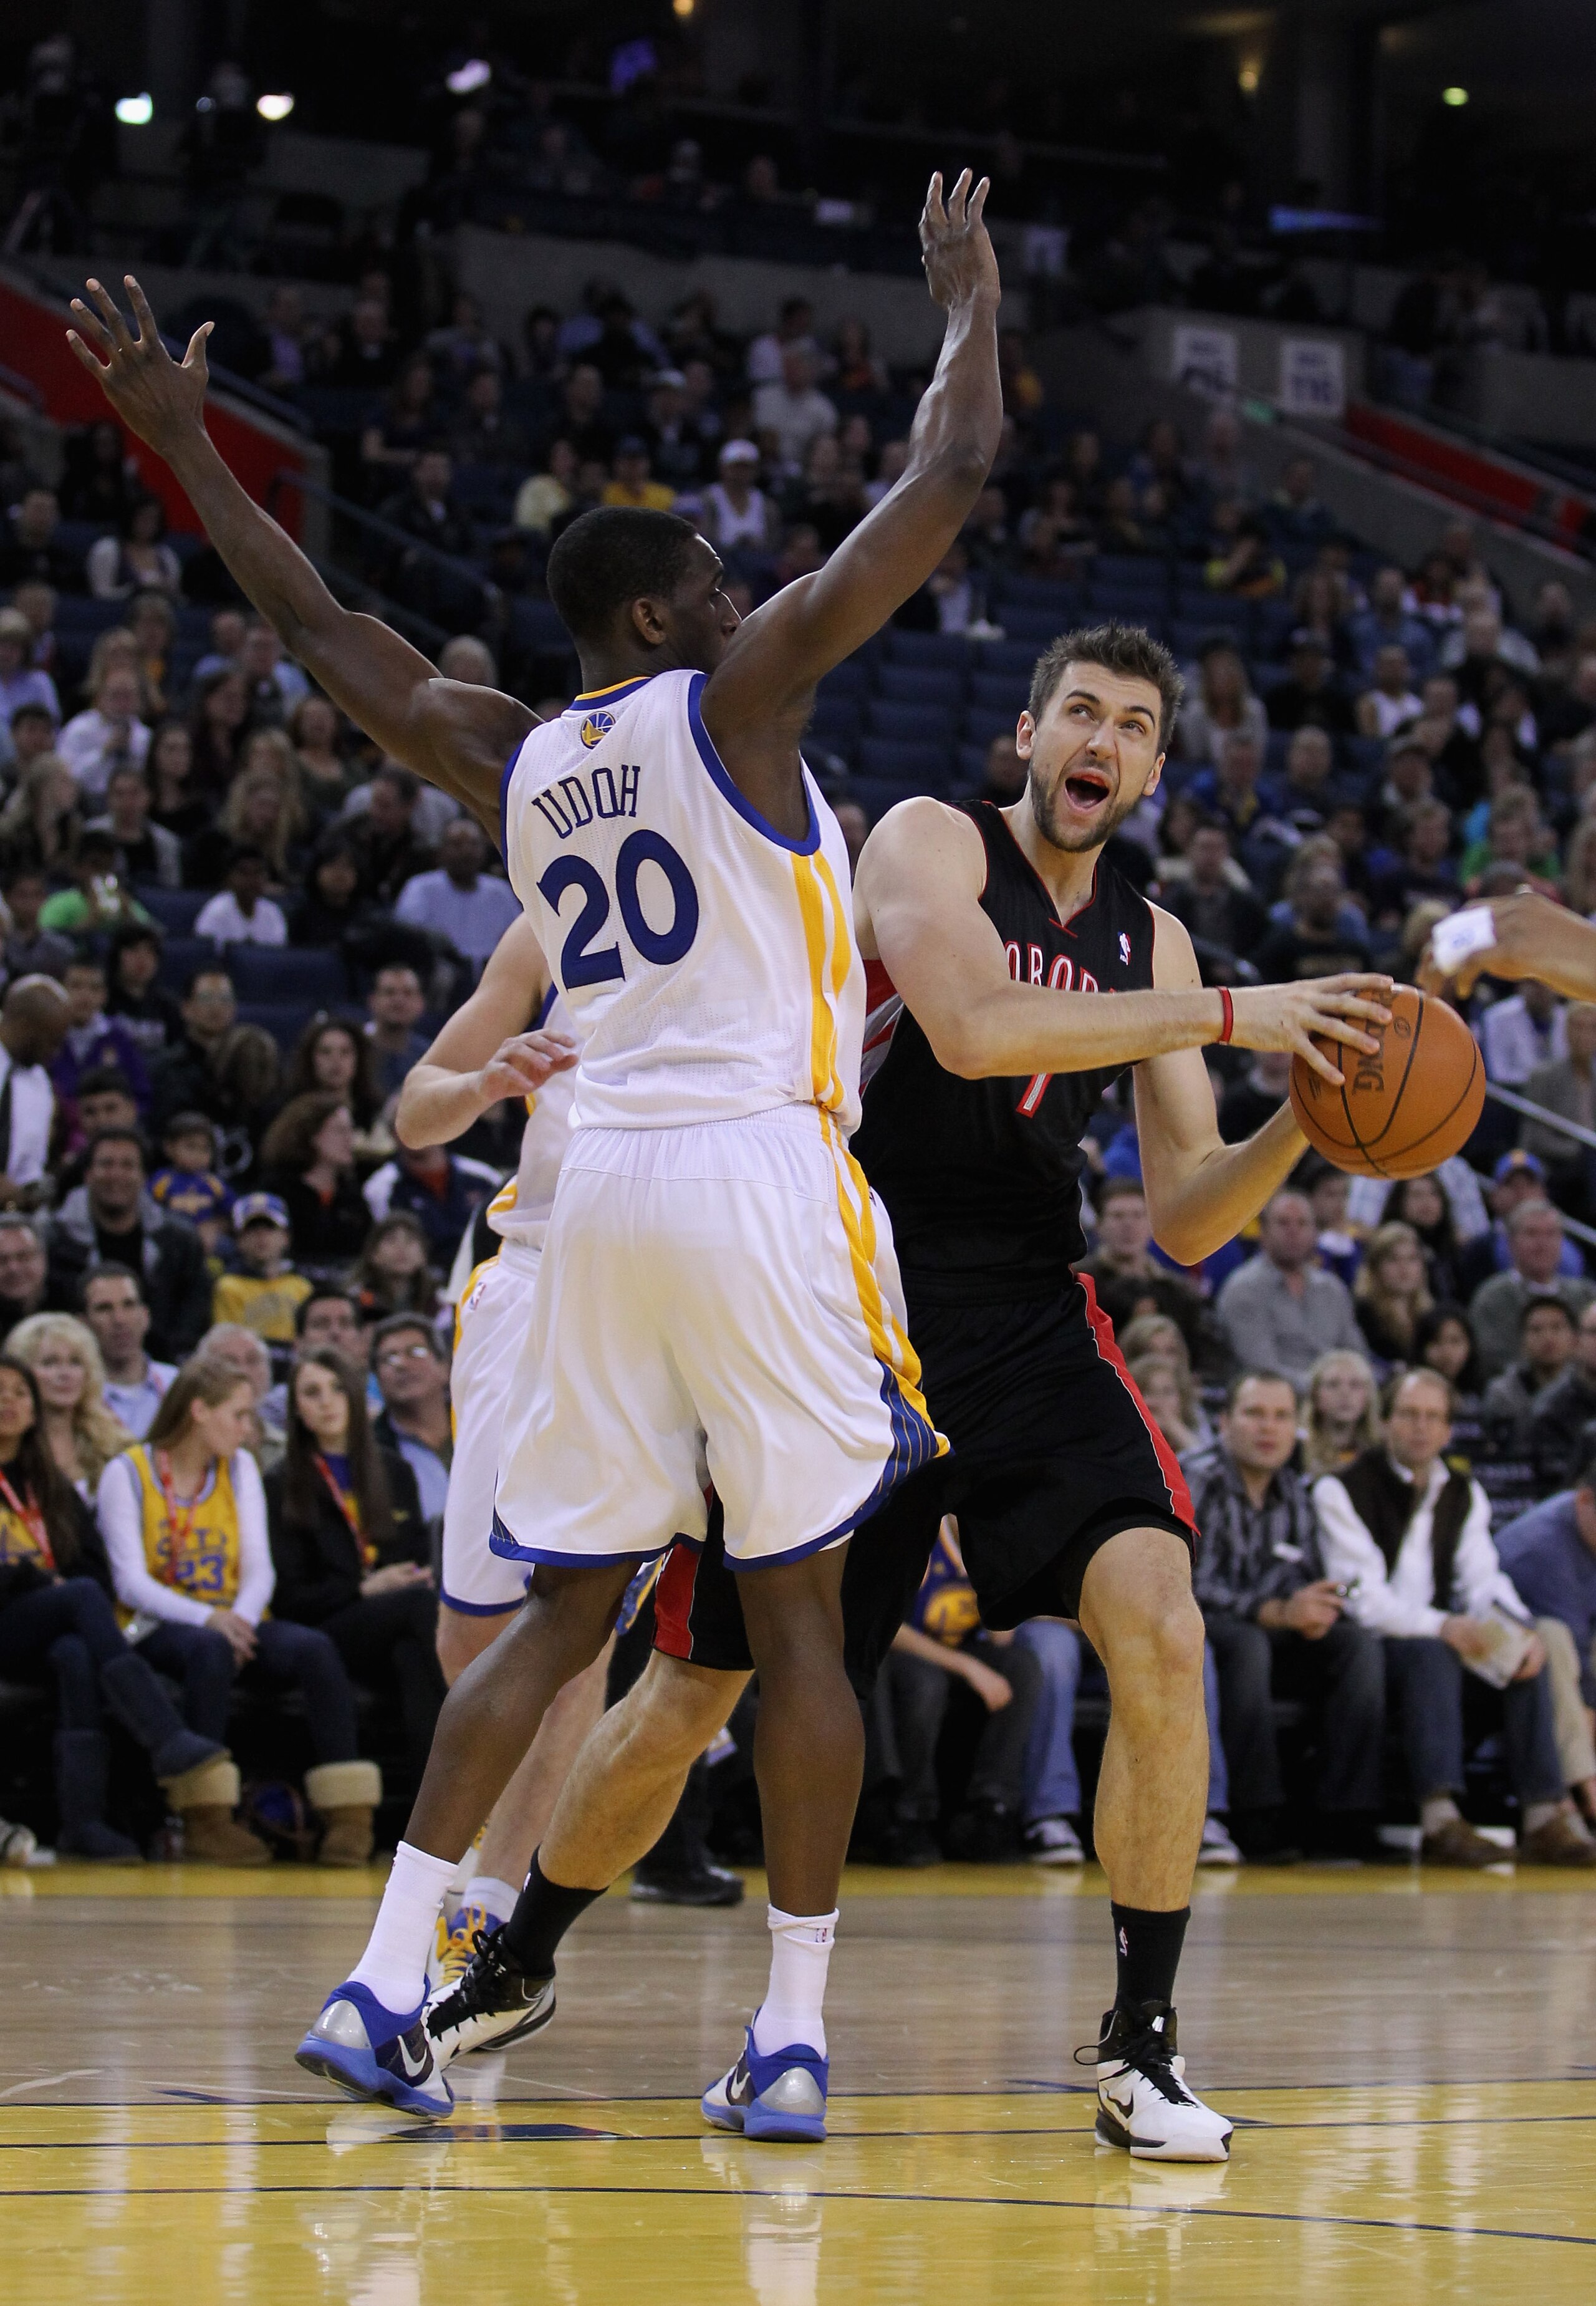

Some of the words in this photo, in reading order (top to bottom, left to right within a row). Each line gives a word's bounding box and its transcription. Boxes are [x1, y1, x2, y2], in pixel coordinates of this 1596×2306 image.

[532, 764, 641, 840] UDOH
[536, 829, 699, 994] 20
[175, 1553, 226, 1592] 23
